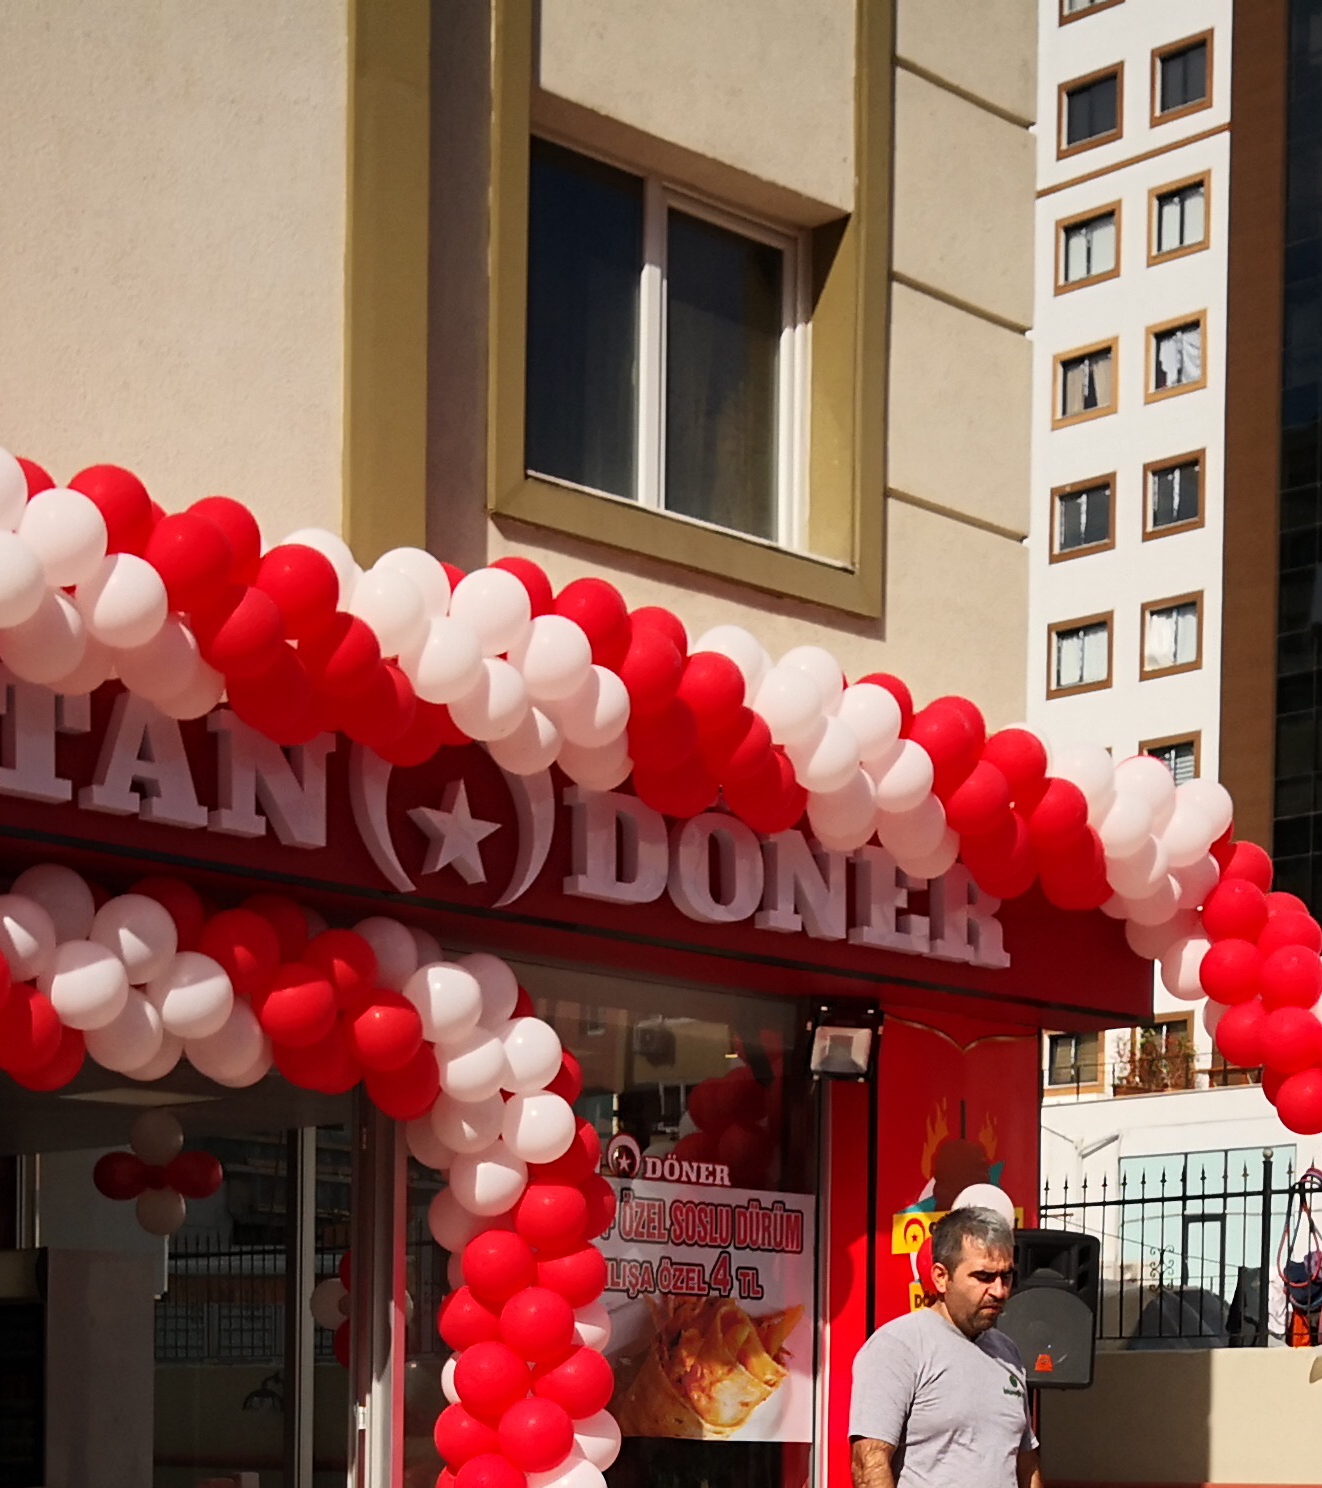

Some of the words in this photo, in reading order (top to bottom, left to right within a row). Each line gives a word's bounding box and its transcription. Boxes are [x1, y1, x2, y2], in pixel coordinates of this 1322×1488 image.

[645, 1154, 731, 1186] DÖNER
[621, 1188, 670, 1244] ÖZEL
[670, 1200, 733, 1248] SOSLU
[735, 1198, 803, 1254] DÜRÜM
[656, 1256, 710, 1294] ÖZEL
[710, 1251, 732, 1297] 4
[736, 1266, 764, 1299] TL
